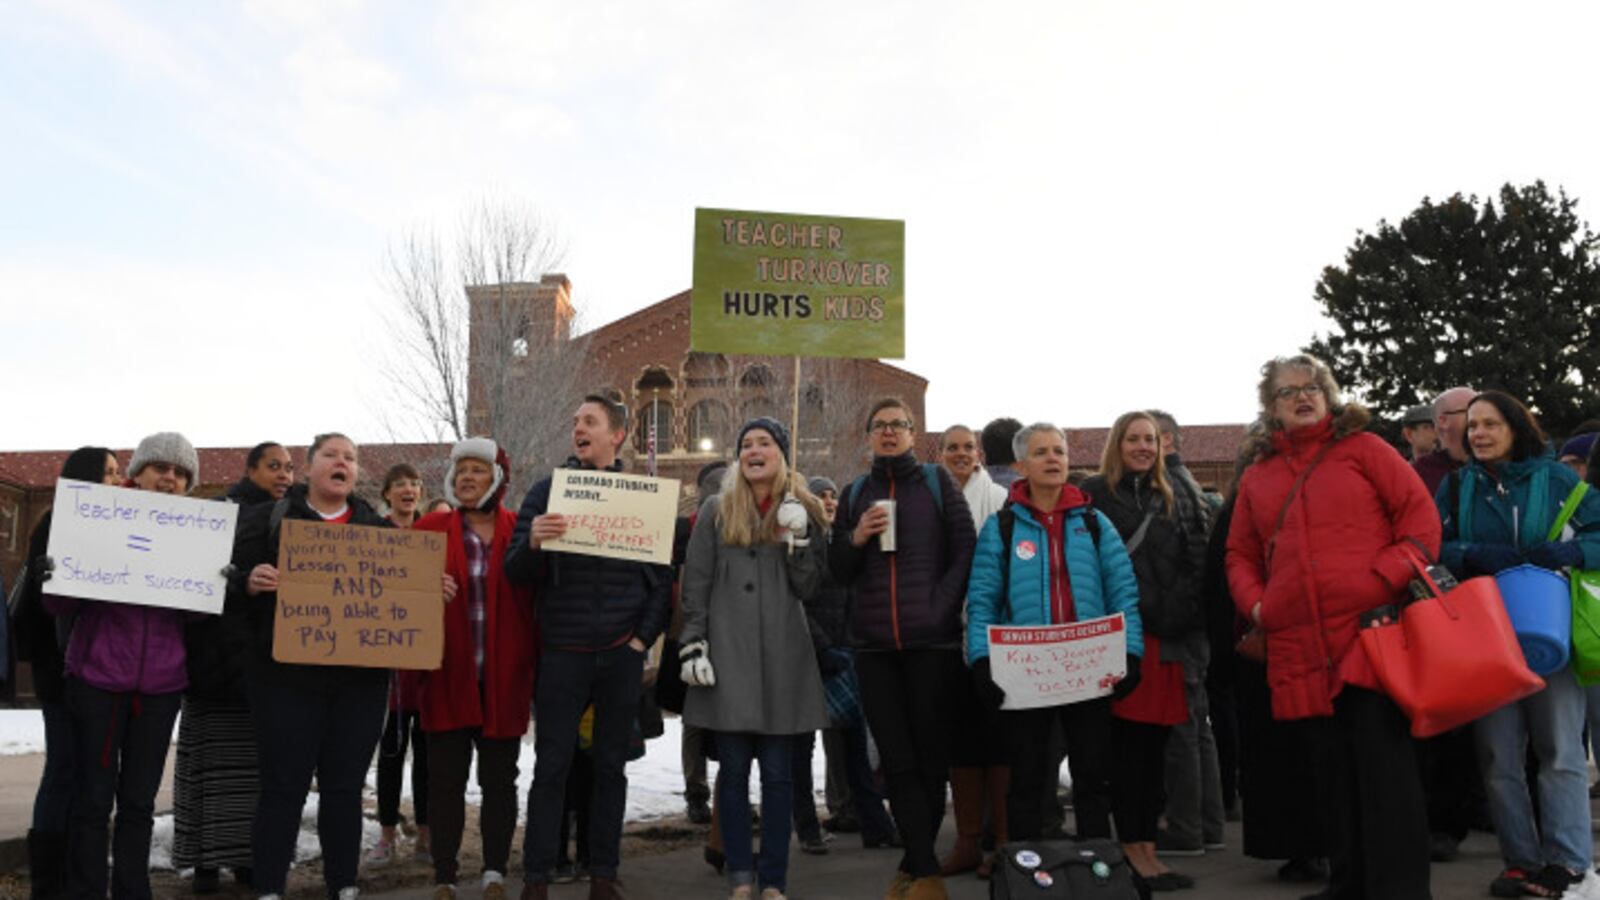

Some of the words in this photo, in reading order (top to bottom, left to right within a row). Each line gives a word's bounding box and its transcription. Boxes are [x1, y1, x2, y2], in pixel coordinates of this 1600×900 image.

[722, 217, 844, 252] TEACHER
[758, 256, 892, 287] TURNOVER
[723, 292, 813, 319] HURTS
[823, 295, 886, 322] KIDS
[566, 475, 613, 488] COLORADO
[614, 479, 659, 493] STUDENTS
[67, 485, 139, 521] Teacher
[149, 506, 227, 531] retention
[62, 556, 130, 585] Student
[144, 573, 214, 596] success
[287, 557, 347, 573] Lesson
[332, 577, 383, 599] AND
[281, 600, 332, 627] being
[343, 603, 381, 621] able
[390, 604, 408, 621] to
[358, 628, 422, 647] RENT
[1001, 629, 1033, 642] DENVER
[1034, 627, 1076, 641] STUDENTS
[1077, 620, 1112, 637] DESERVE
